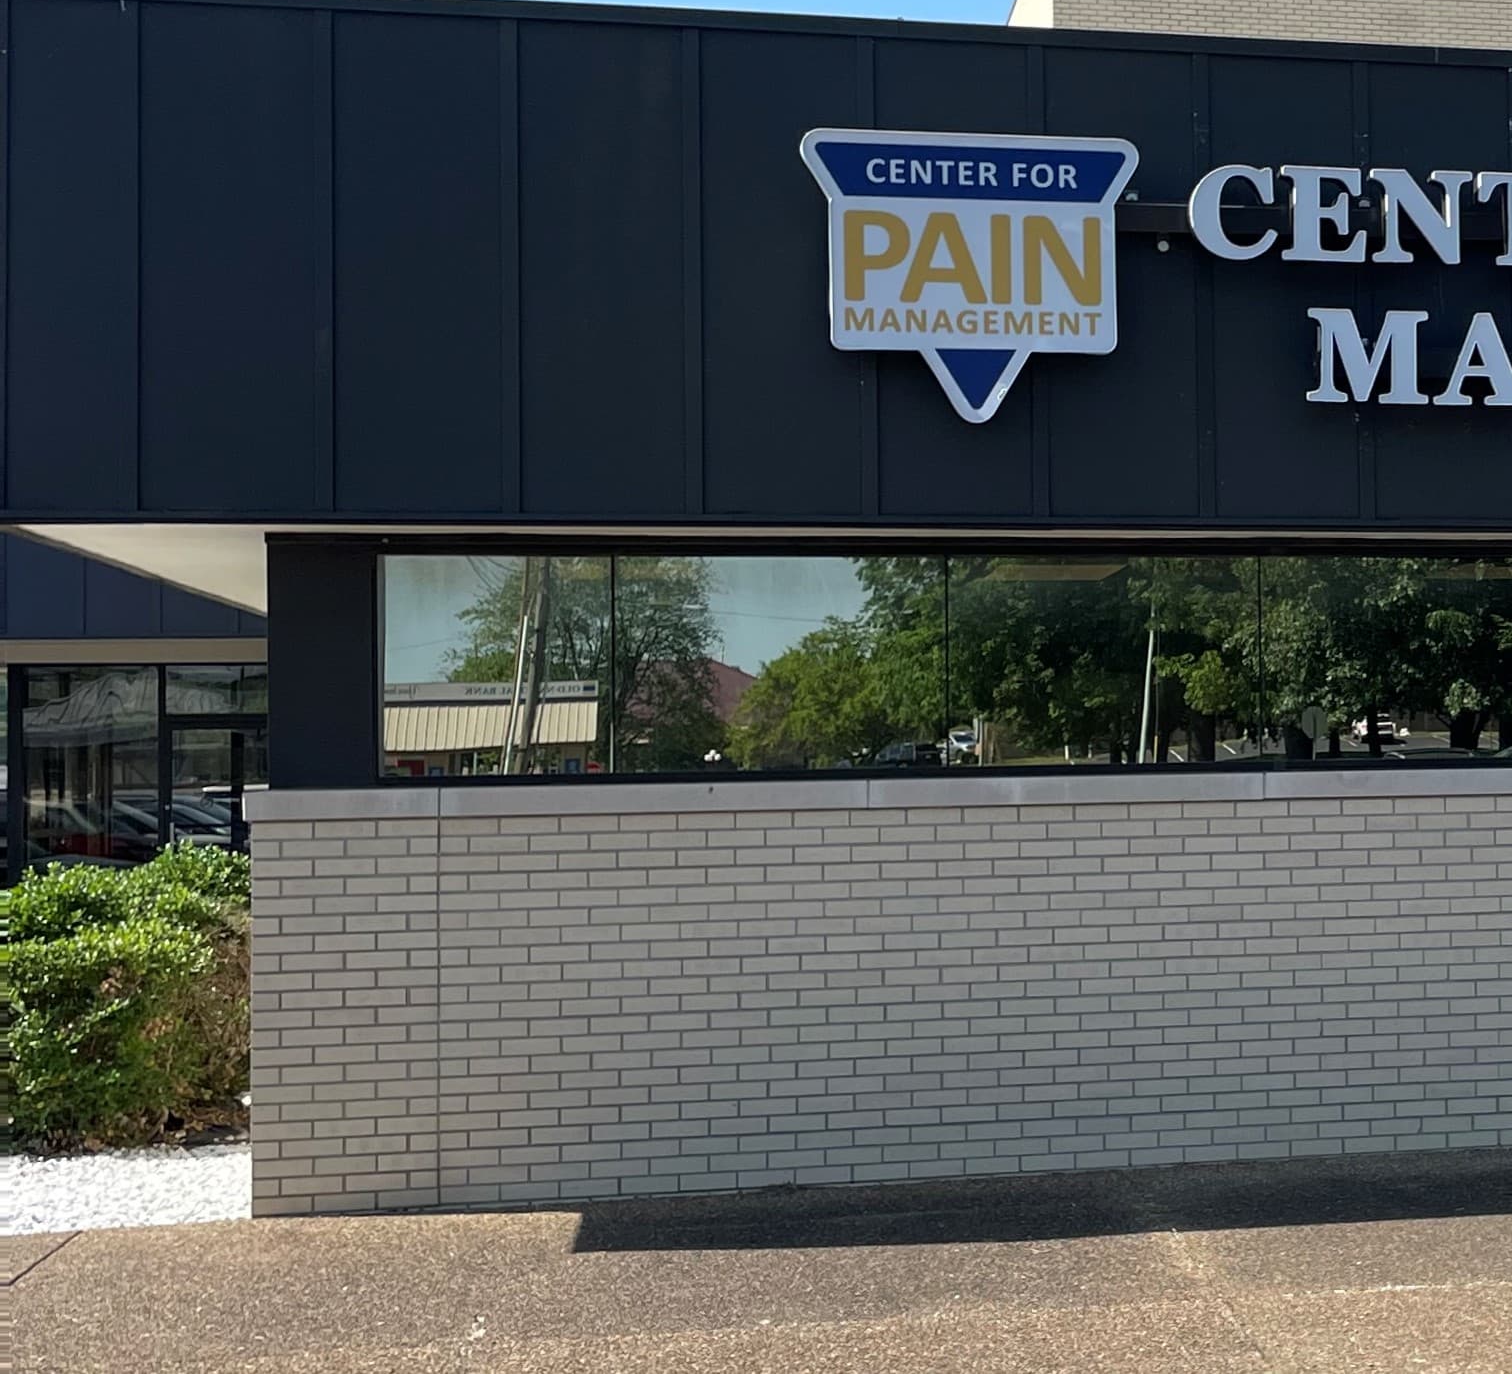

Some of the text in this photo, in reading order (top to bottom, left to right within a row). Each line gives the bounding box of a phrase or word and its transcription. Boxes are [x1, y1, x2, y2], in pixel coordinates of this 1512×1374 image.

[866, 158, 1078, 190] CENTER FOR
[843, 209, 1103, 307] PAIN
[844, 307, 1103, 336] MANAGEMENT
